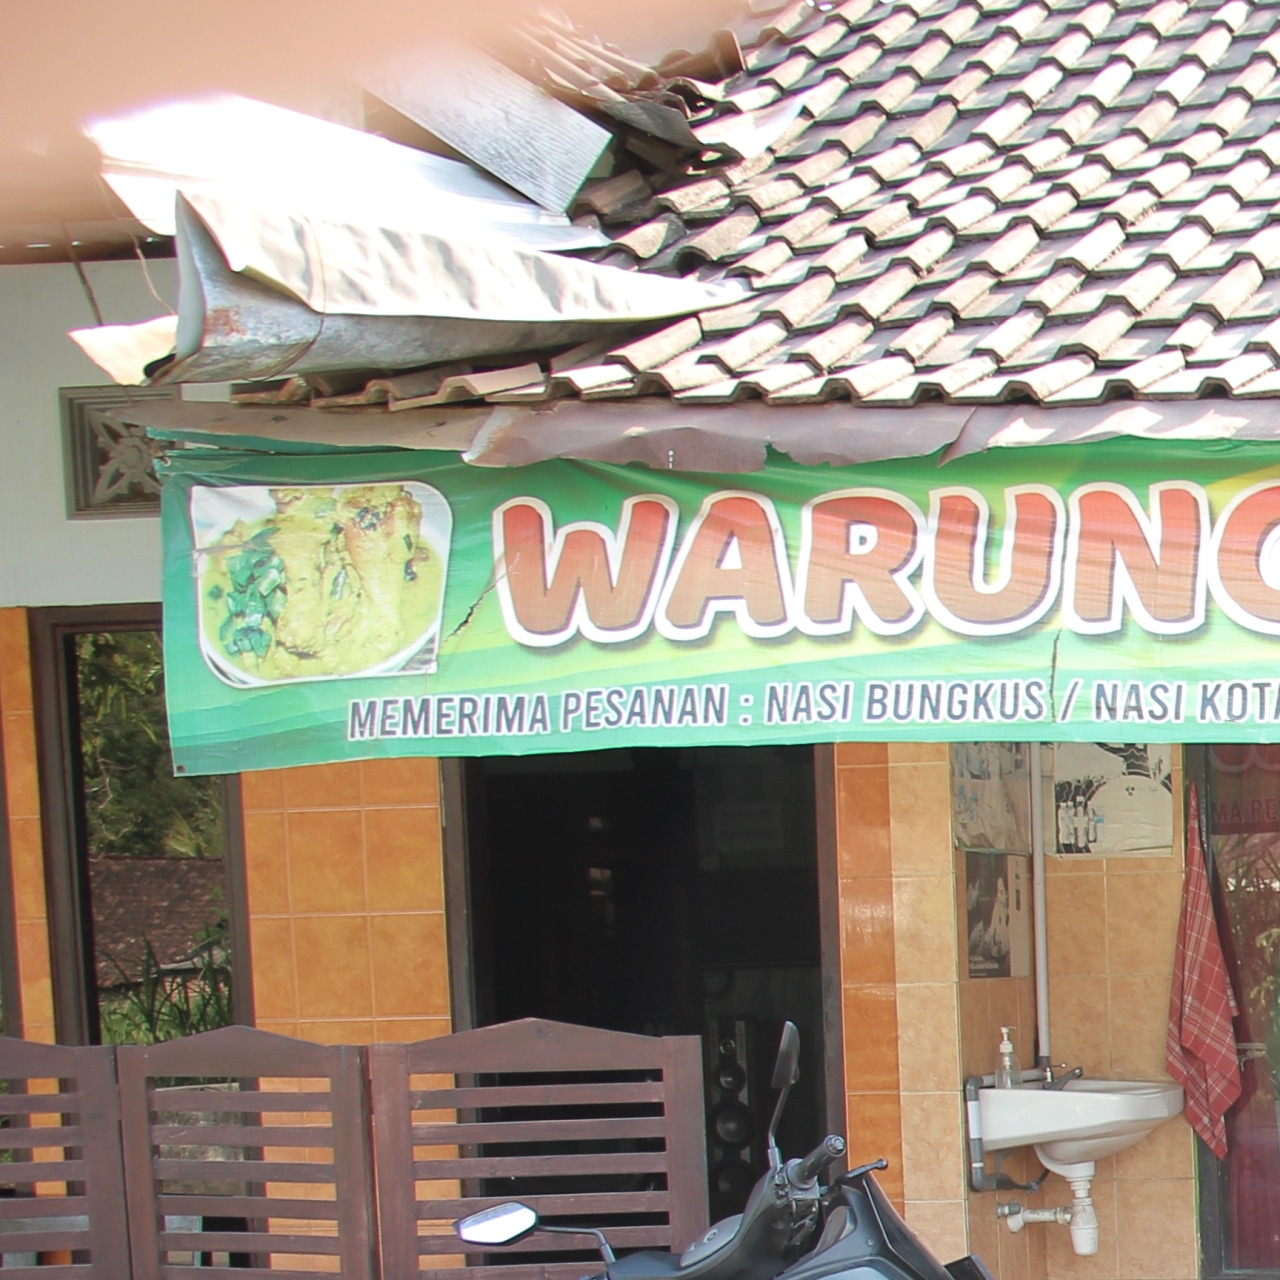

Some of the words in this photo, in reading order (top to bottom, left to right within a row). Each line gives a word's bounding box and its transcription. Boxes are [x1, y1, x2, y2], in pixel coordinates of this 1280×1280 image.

[349, 693, 550, 740] MEMERIMA
[561, 683, 728, 731] PESANAN
[739, 694, 753, 726] :
[765, 680, 851, 724] NASI
[862, 680, 1045, 723] BUNGKUS
[1059, 678, 1082, 723] /
[1093, 680, 1186, 724] NASI
